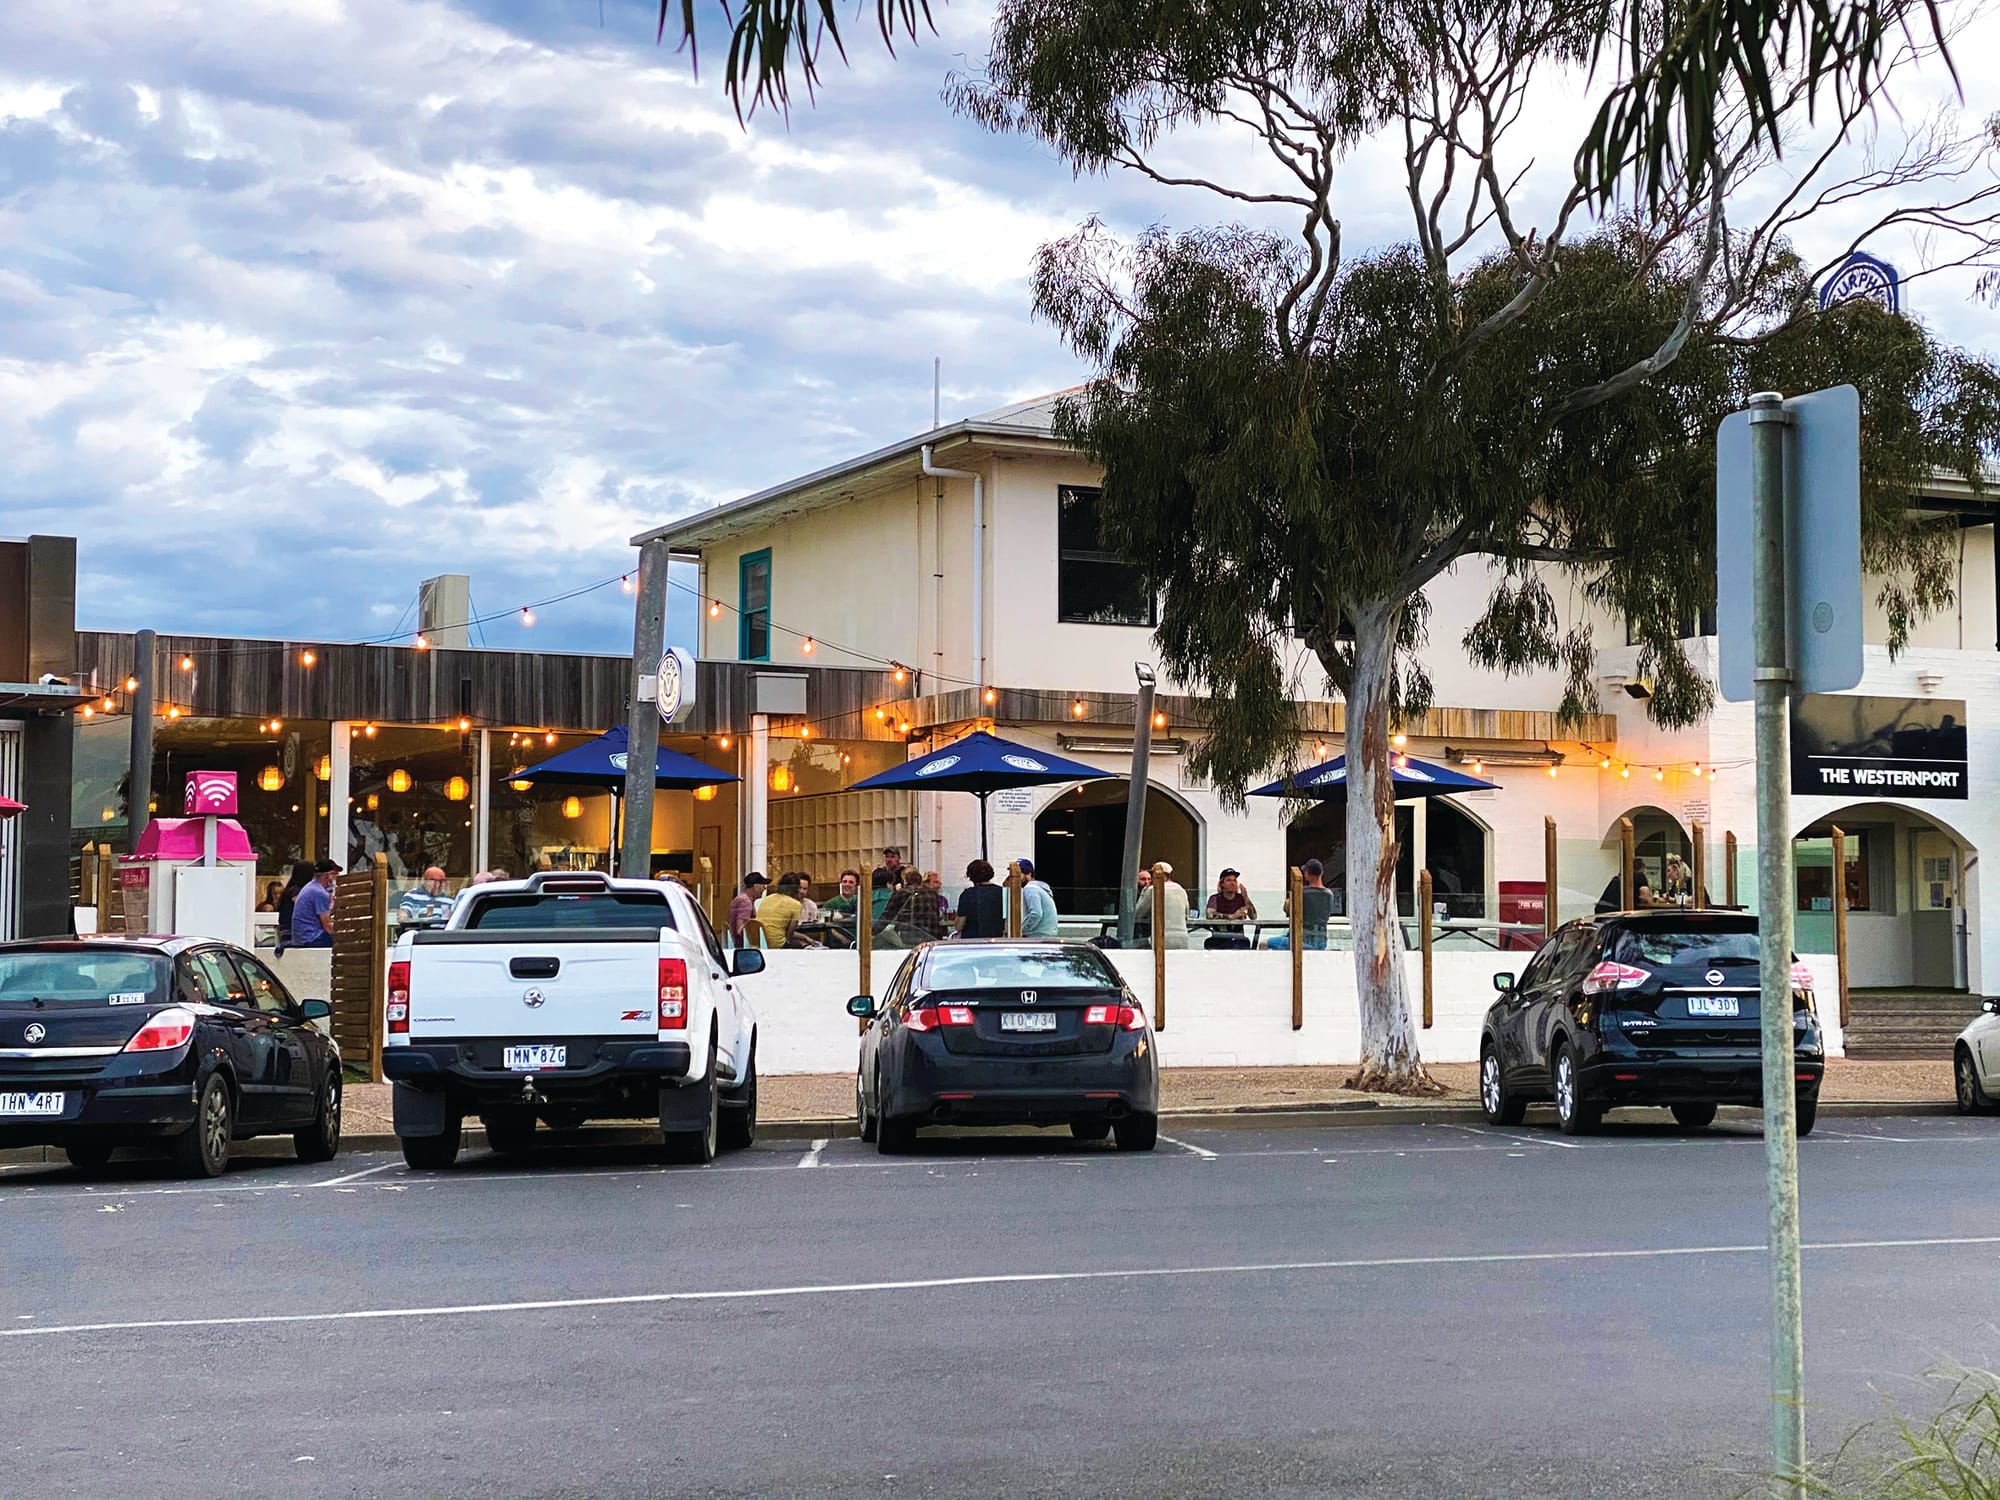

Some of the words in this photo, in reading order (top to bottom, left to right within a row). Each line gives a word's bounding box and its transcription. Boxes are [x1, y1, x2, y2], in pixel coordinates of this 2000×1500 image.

[1819, 768, 1850, 783] THE
[1853, 769, 1960, 787] WESTERNPORT
[36, 1095, 62, 1109] 4RT
